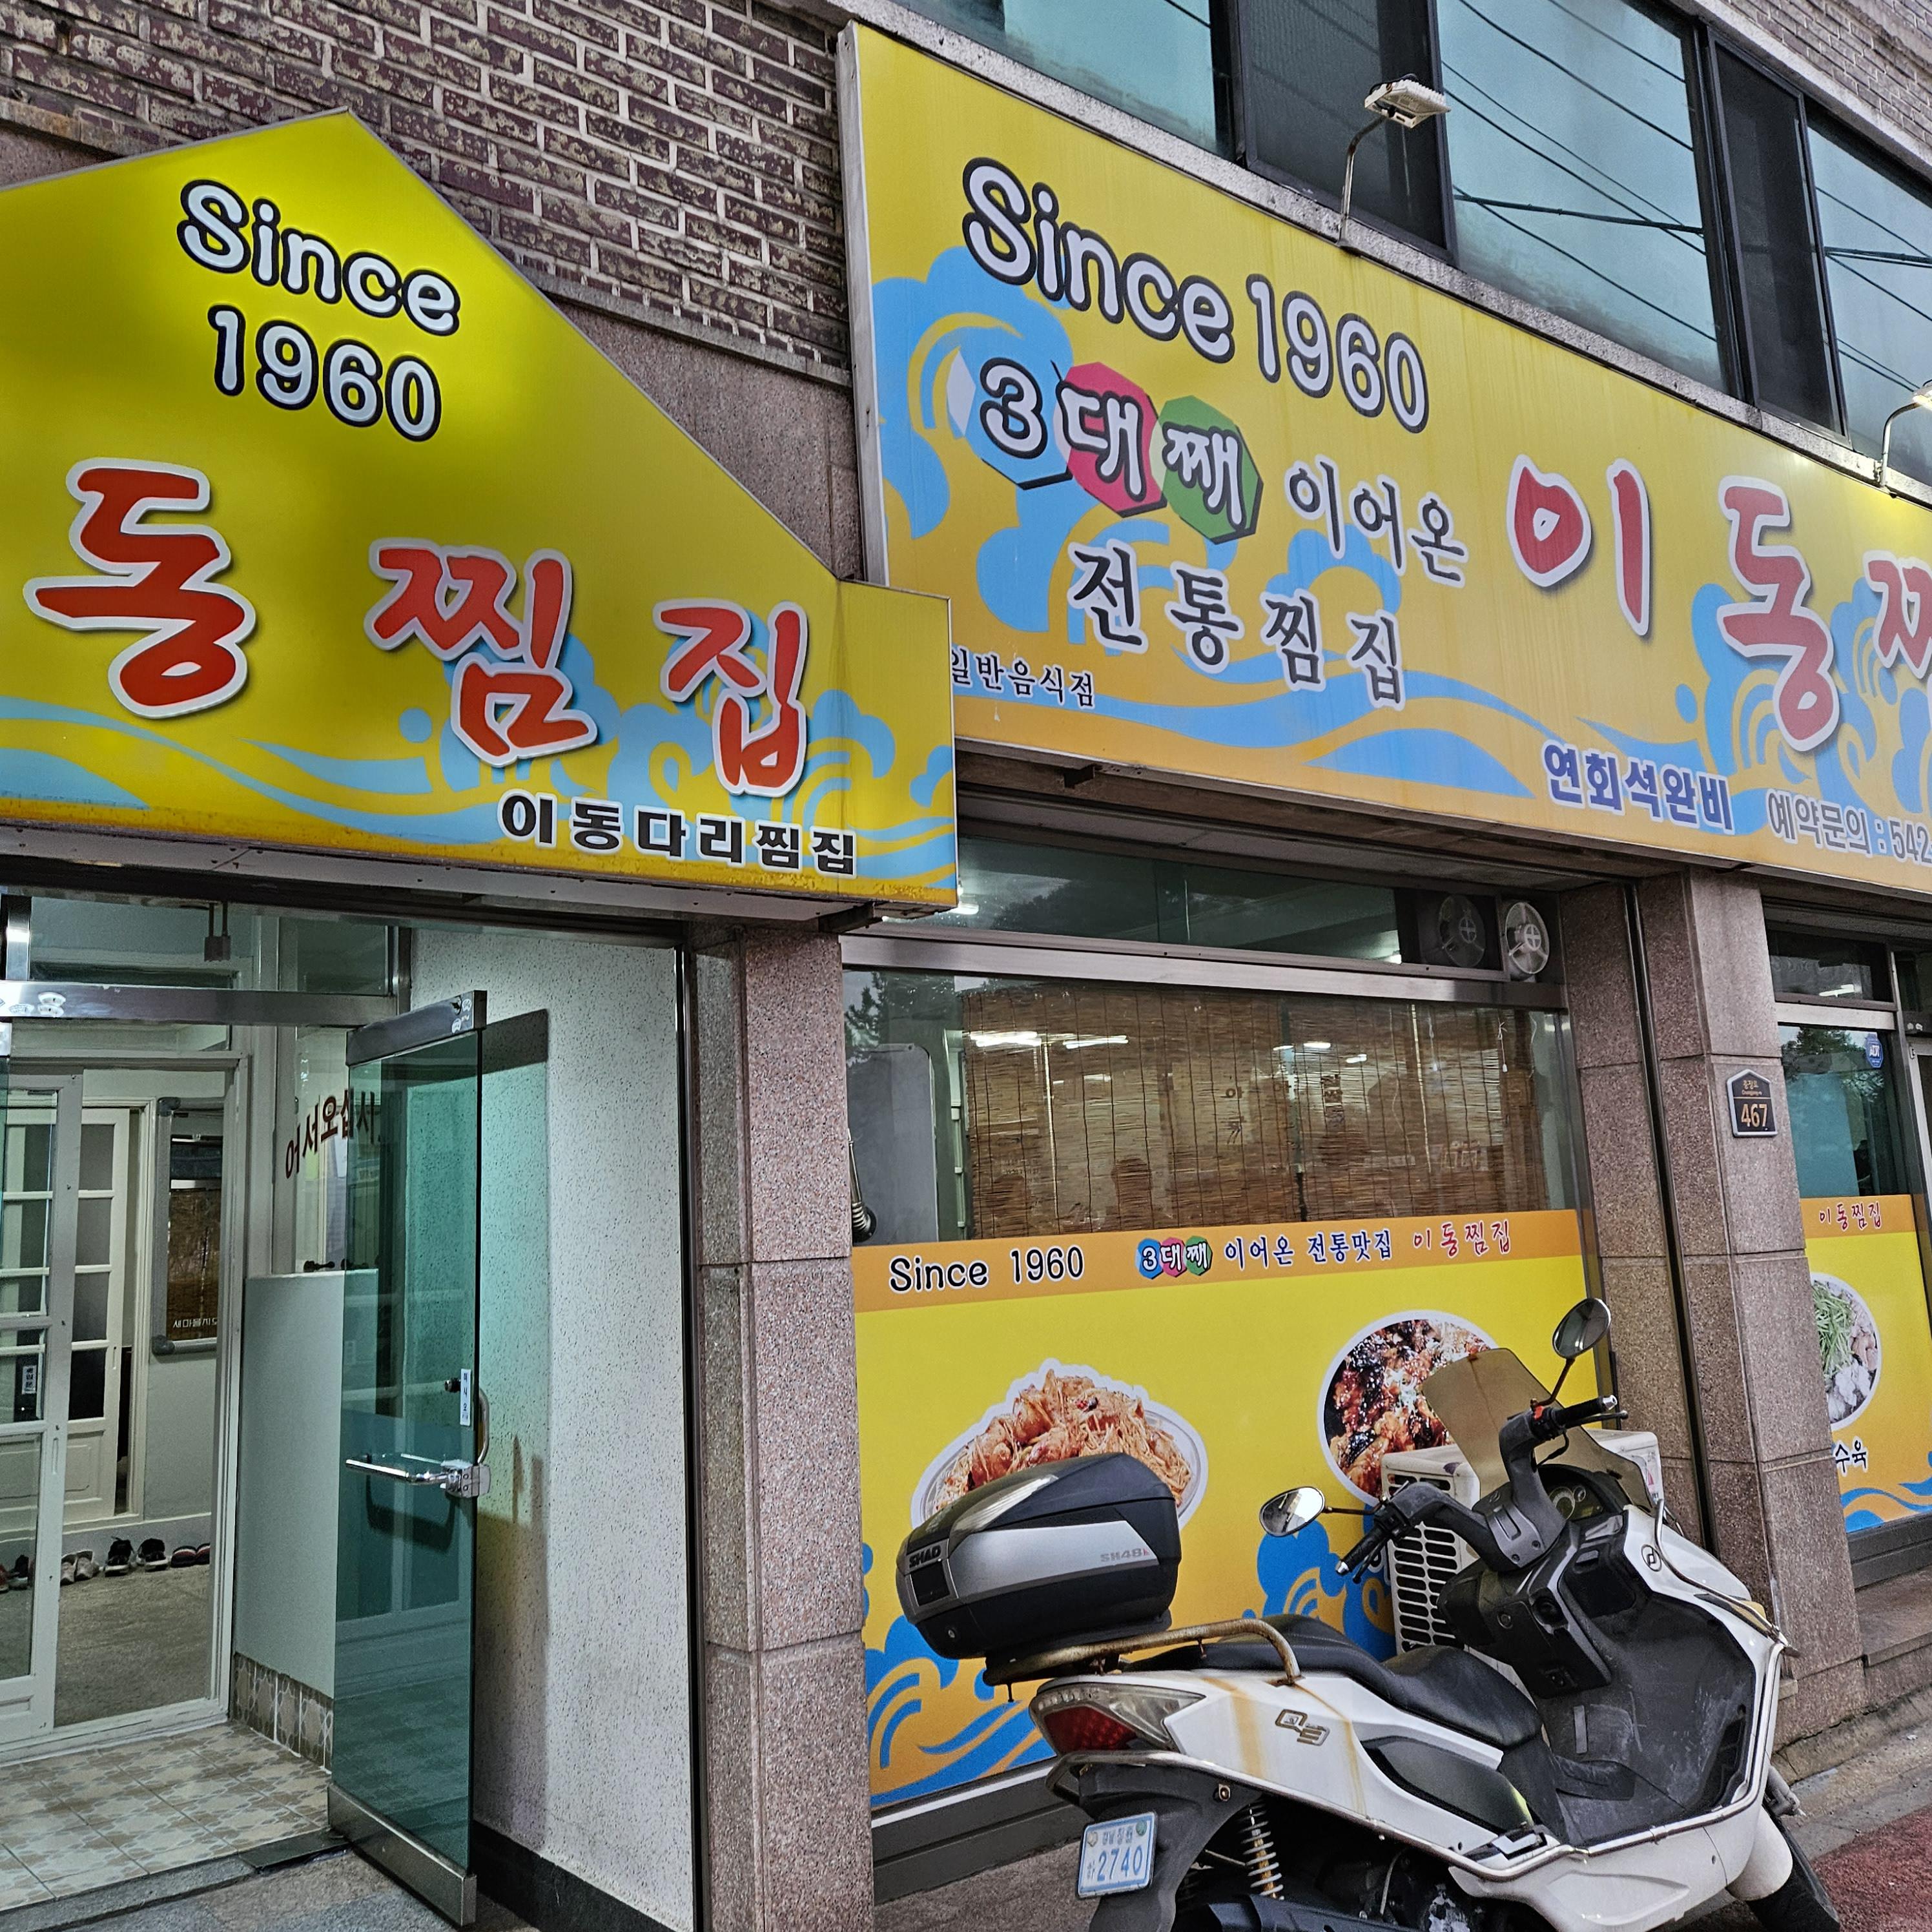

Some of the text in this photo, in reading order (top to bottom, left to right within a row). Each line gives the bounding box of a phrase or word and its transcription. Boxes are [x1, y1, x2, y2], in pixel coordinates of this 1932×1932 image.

[177, 180, 460, 336] Since
[962, 157, 1428, 433] Since 1960
[208, 304, 442, 442] 1960
[980, 358, 1468, 584] 3대째 이어온
[952, 648, 1093, 707] 일반음식점
[1543, 741, 1733, 832] 연회석완비
[499, 791, 856, 876] 이동다리찜집
[285, 1087, 381, 1179] 어서오십시
[1741, 1104, 1767, 1127] 467
[890, 1257, 989, 1293] Since
[1011, 1246, 1084, 1284] 1960
[1140, 1240, 1209, 1273] 3대째
[1225, 1237, 1294, 1270] 이어온
[1307, 1230, 1391, 1264] 전통맛집
[909, 1544, 941, 1568] SHAD
[1097, 1845, 1143, 1882] 2740
